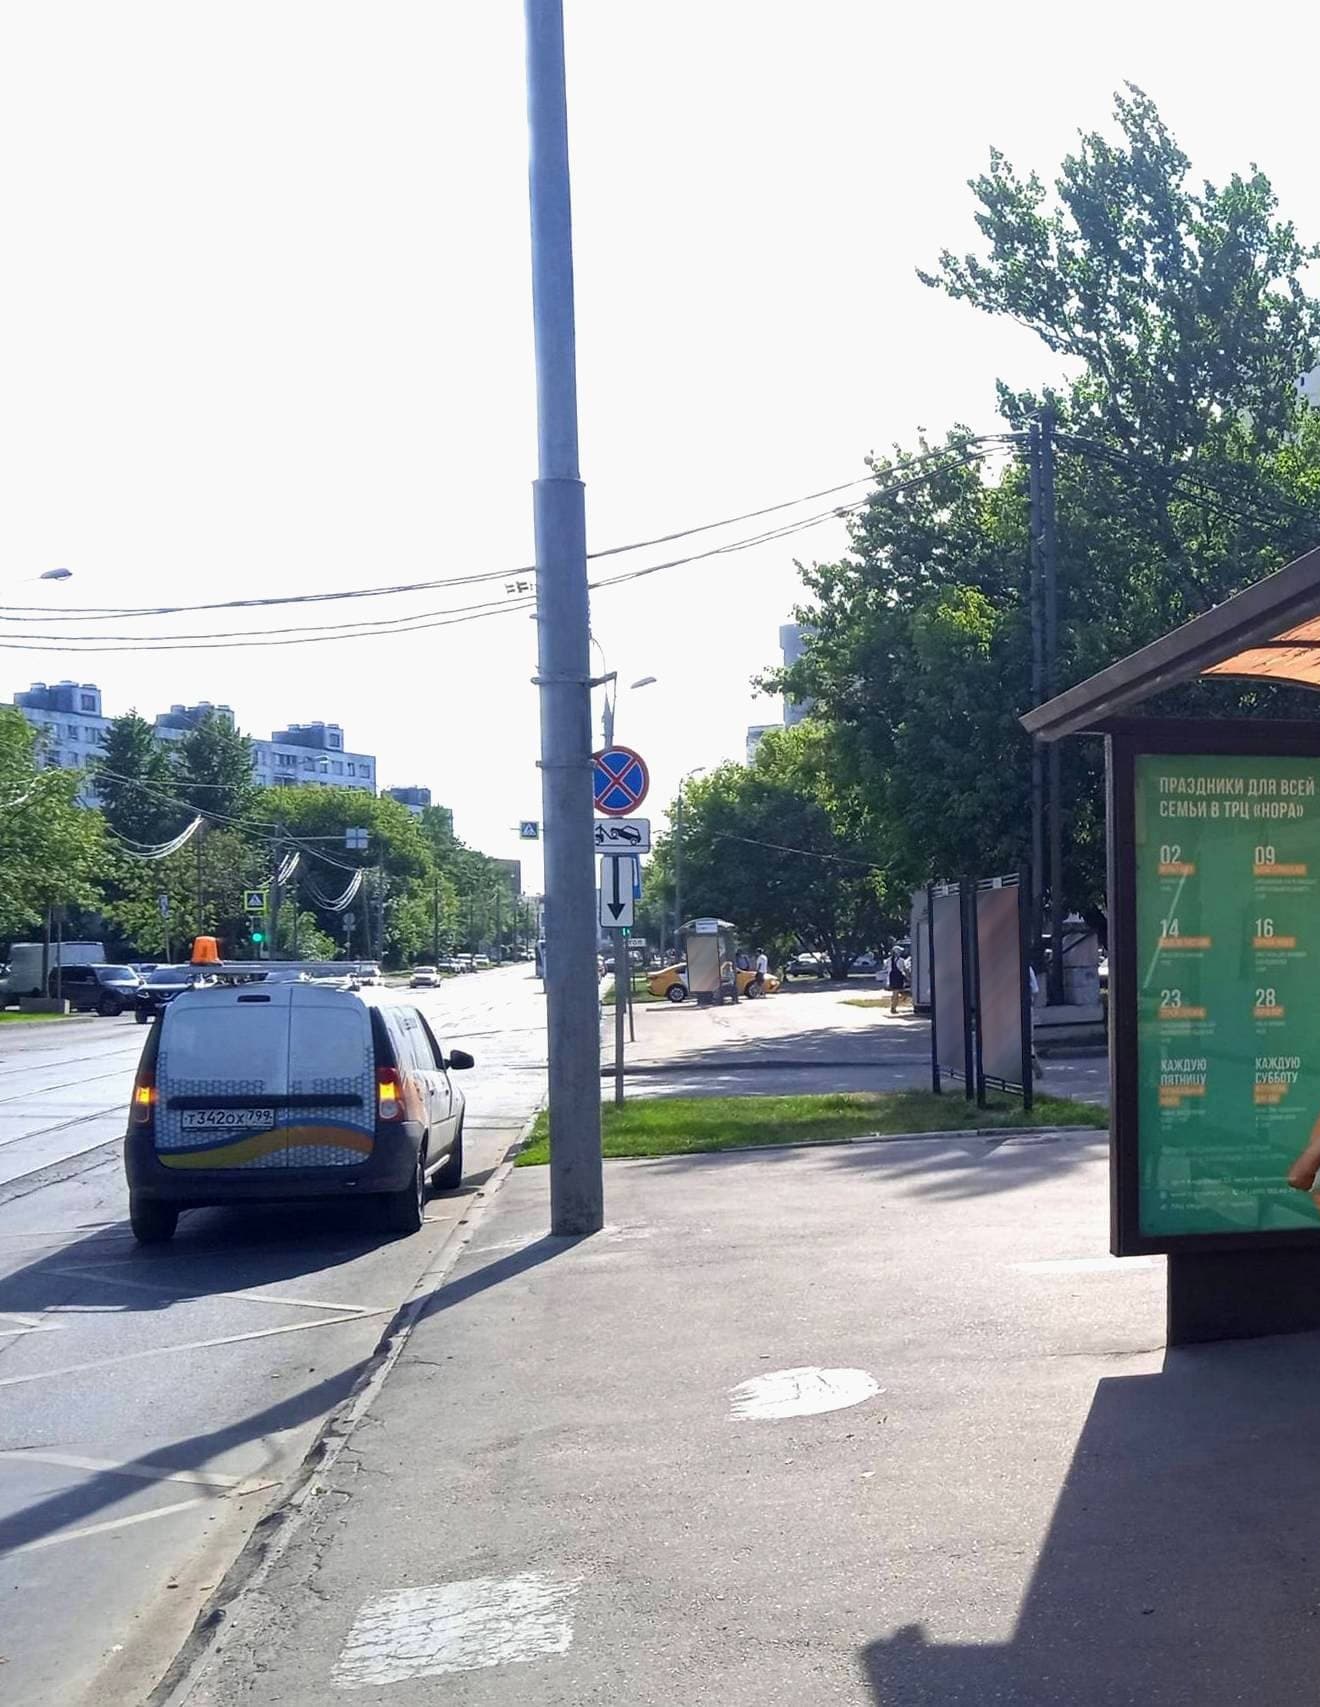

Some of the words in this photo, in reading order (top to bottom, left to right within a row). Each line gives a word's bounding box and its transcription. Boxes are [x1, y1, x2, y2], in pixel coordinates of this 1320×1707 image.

[1159, 777, 1244, 795] ПРАЗДНИКИ
[1248, 778, 1277, 797] ДЛЯ
[1281, 776, 1315, 795] ВСЕЙ
[1159, 801, 1207, 818] СЕМЬИ
[1210, 801, 1219, 818] В
[1223, 801, 1249, 820] ТРЦ
[1253, 801, 1304, 819] «НОРА»
[1160, 845, 1181, 865] 02
[1255, 846, 1276, 865] 09
[1160, 918, 1180, 938] 14
[1255, 918, 1274, 938] 16
[1160, 989, 1181, 1008] 23
[1255, 988, 1276, 1008] 28
[1160, 1058, 1207, 1072] КАЖДУЮ
[1255, 1056, 1301, 1071] КАЖДУЮ
[1160, 1072, 1207, 1086] ПЯТНИЦУ
[1255, 1070, 1298, 1085] СУББОТУ
